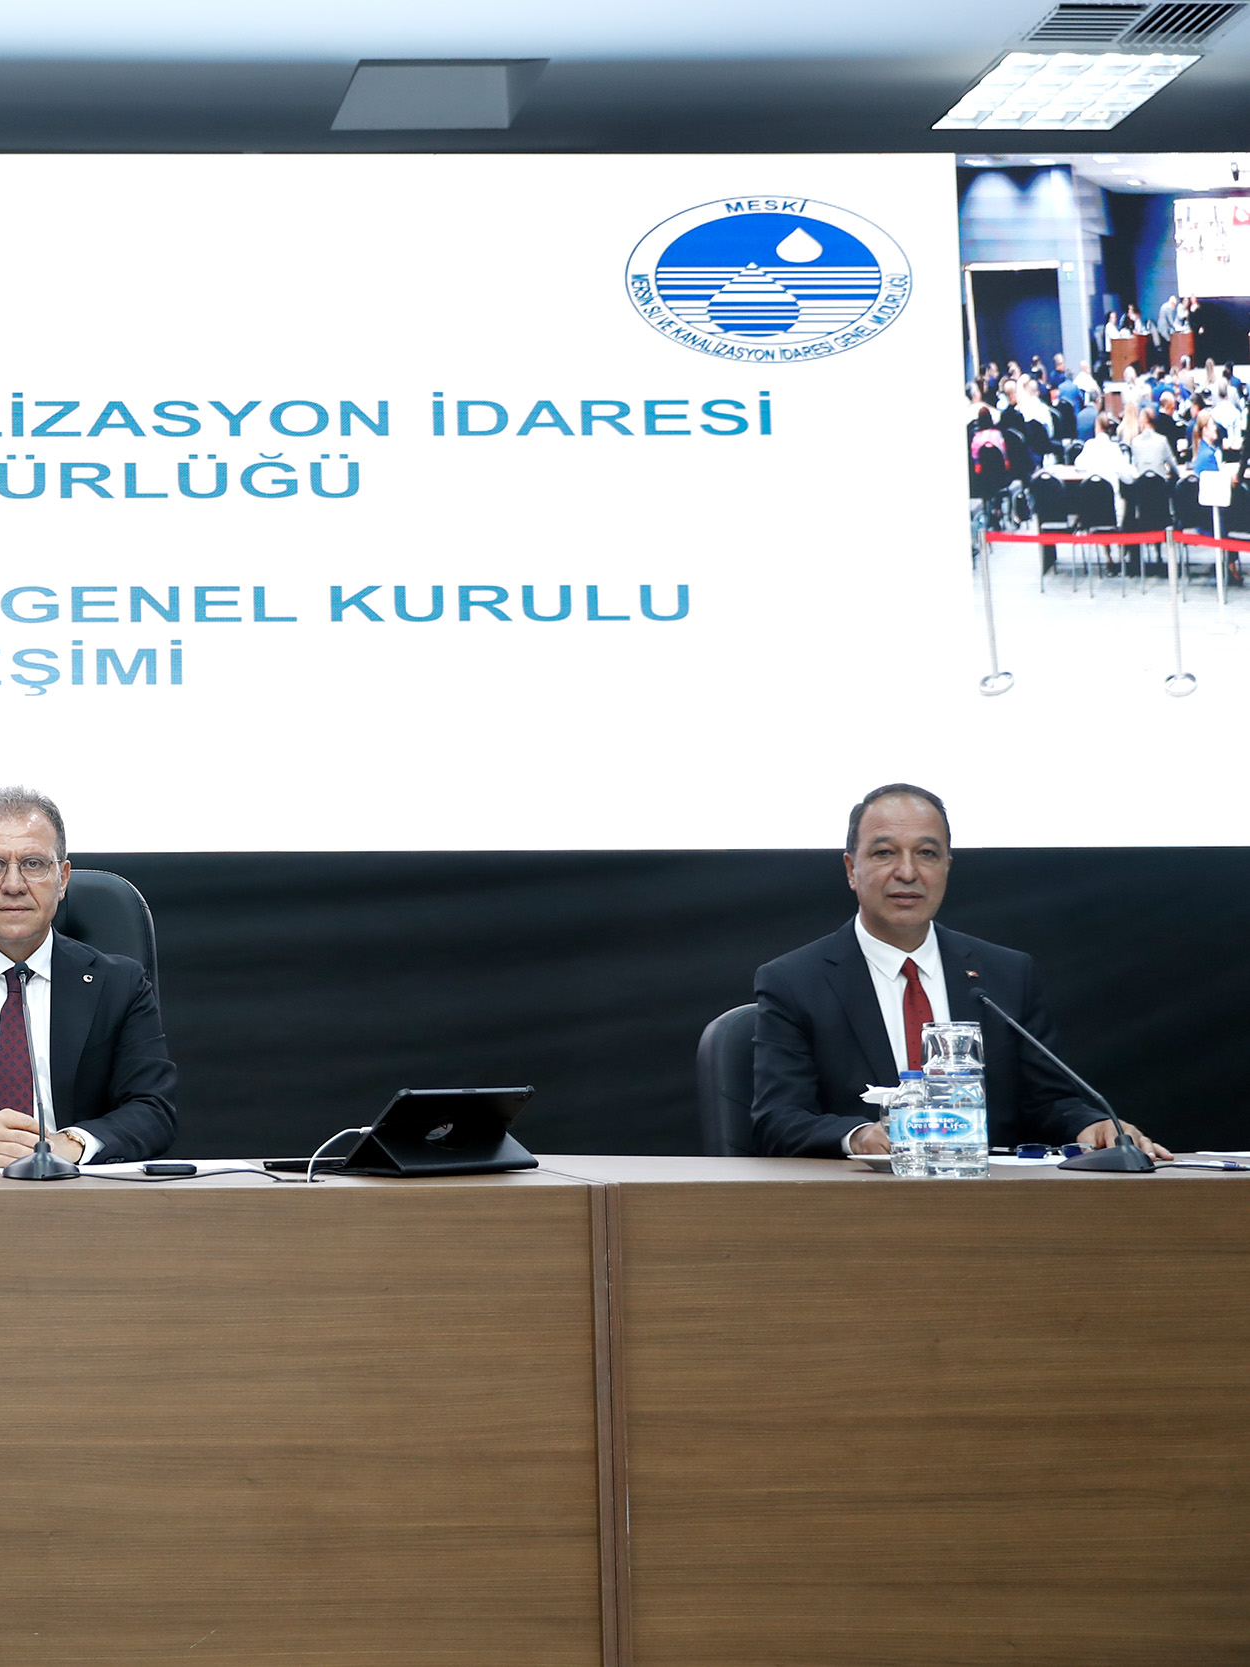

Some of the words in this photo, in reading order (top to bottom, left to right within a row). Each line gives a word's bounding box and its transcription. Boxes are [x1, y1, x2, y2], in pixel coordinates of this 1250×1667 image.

[725, 199, 809, 213] MESKİ
[669, 327, 775, 361] KANALİZASYON
[833, 325, 878, 348] GENEL
[431, 390, 773, 437] İDARESİ
[0, 585, 298, 624] GENEL
[329, 583, 690, 623] KURULU
[943, 1122, 968, 1131] Life
